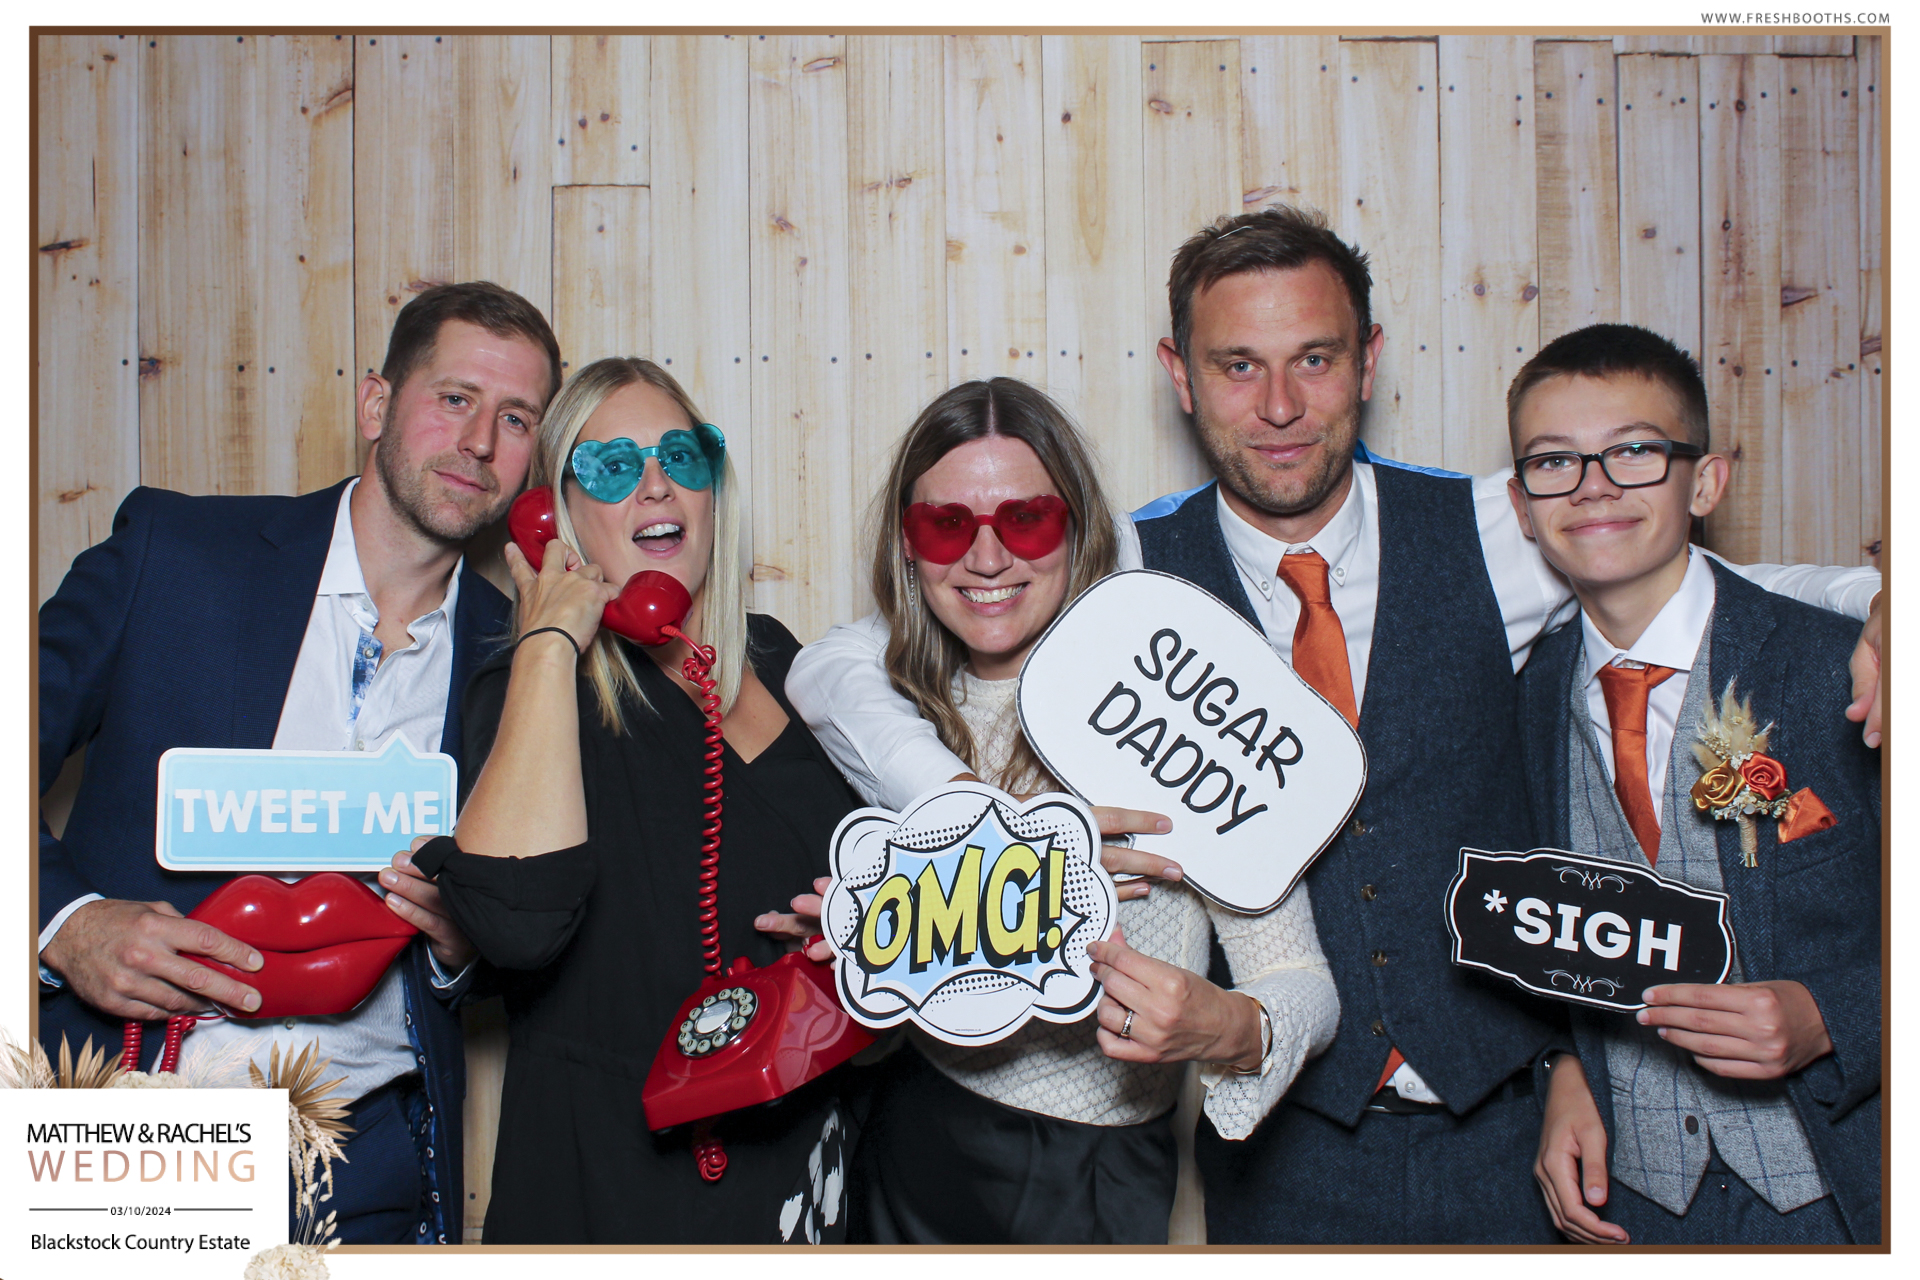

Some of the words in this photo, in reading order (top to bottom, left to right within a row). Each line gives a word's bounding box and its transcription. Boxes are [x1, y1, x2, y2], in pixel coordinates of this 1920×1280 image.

[1087, 681, 1268, 835] DADDY
[1133, 628, 1304, 789] SUGAR
[175, 788, 347, 834] TWEET
[362, 791, 440, 835] ME
[856, 843, 1068, 974] OMG!
